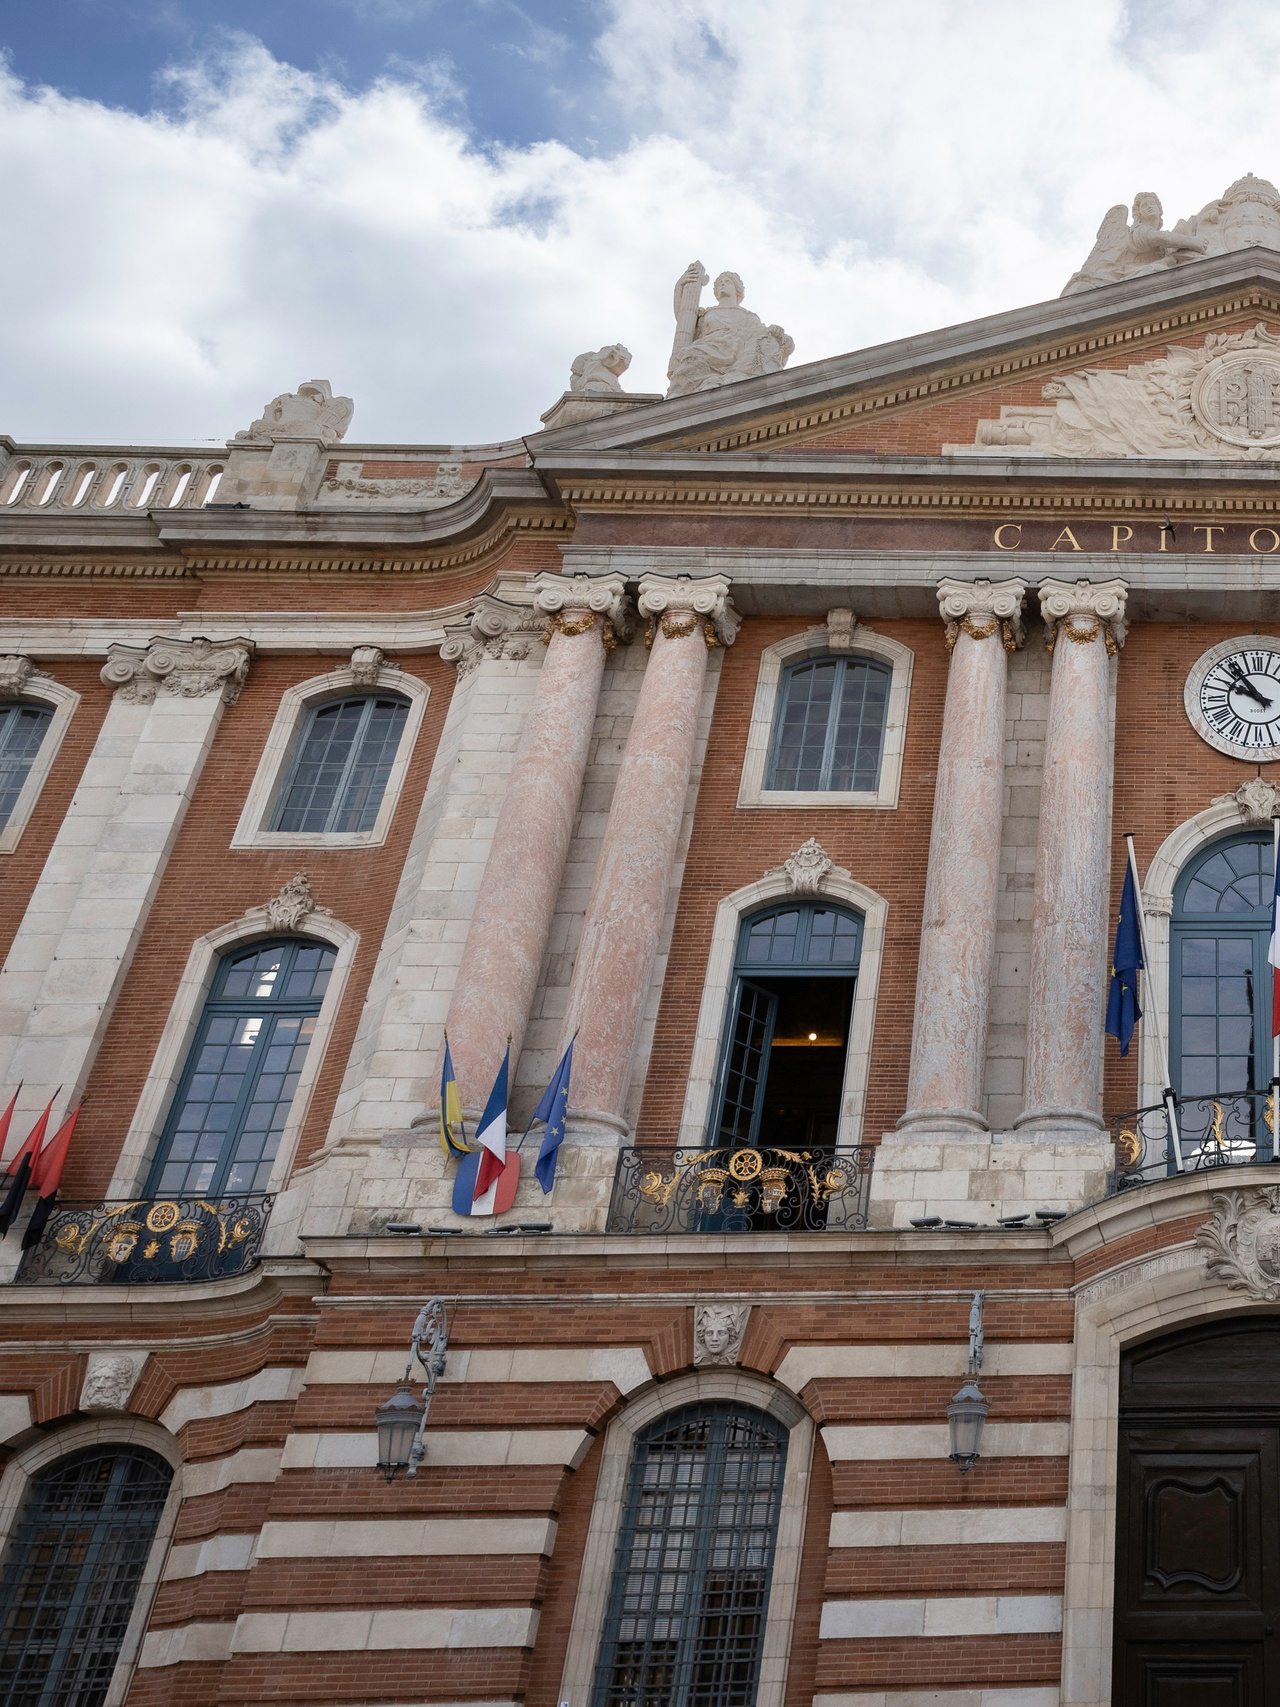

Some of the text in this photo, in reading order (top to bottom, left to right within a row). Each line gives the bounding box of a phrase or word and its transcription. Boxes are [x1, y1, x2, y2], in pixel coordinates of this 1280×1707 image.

[1252, 656, 1263, 672] XII
[1212, 708, 1231, 725] VIII
[1229, 720, 1246, 738] VII
[1254, 726, 1264, 742] VI
